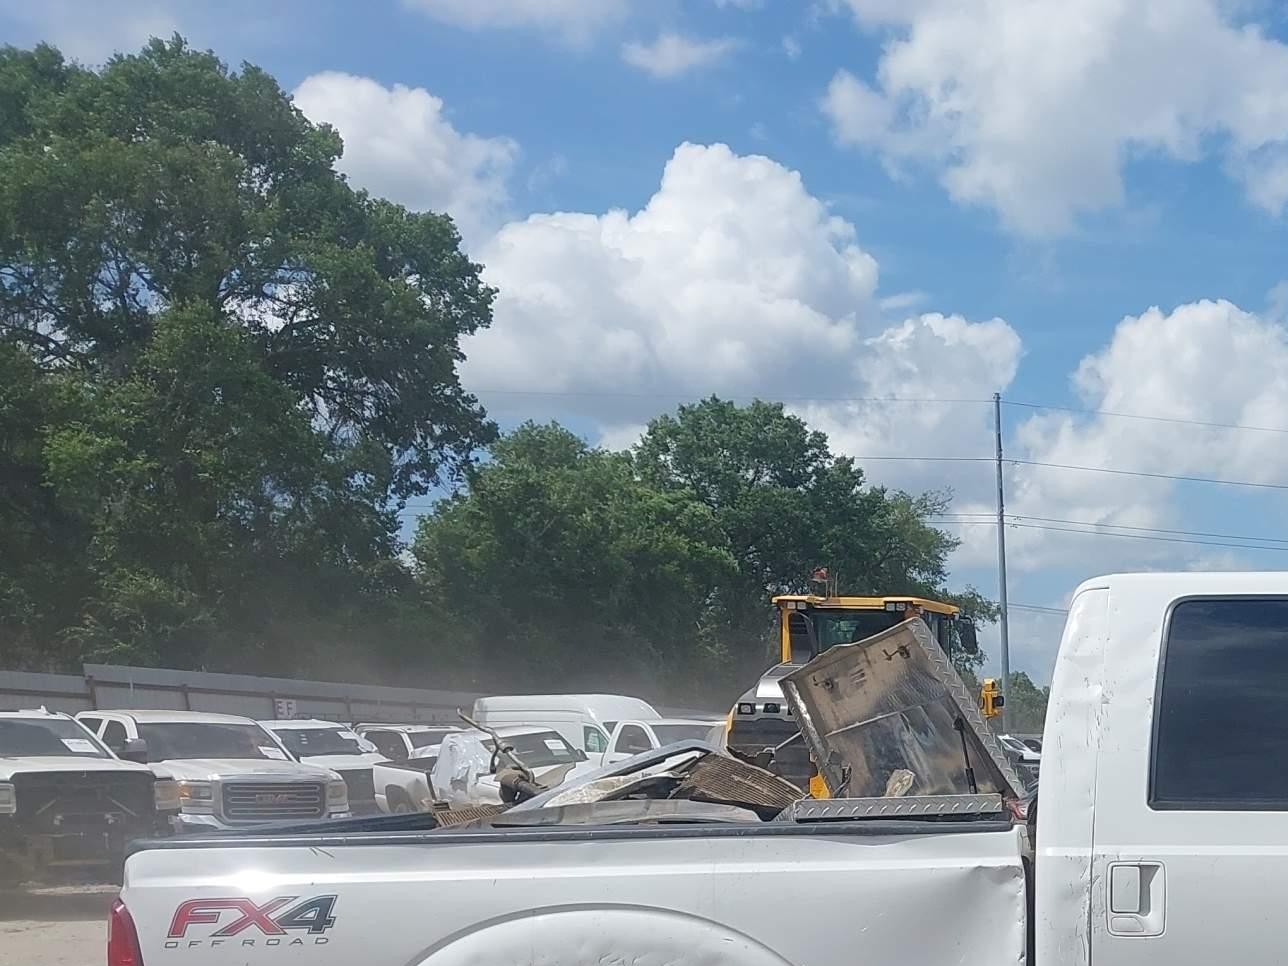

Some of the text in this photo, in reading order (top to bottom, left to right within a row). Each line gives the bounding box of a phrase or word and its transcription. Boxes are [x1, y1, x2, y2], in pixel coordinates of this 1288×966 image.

[167, 894, 338, 938] FX4
[164, 936, 329, 949] OFF ROAD
